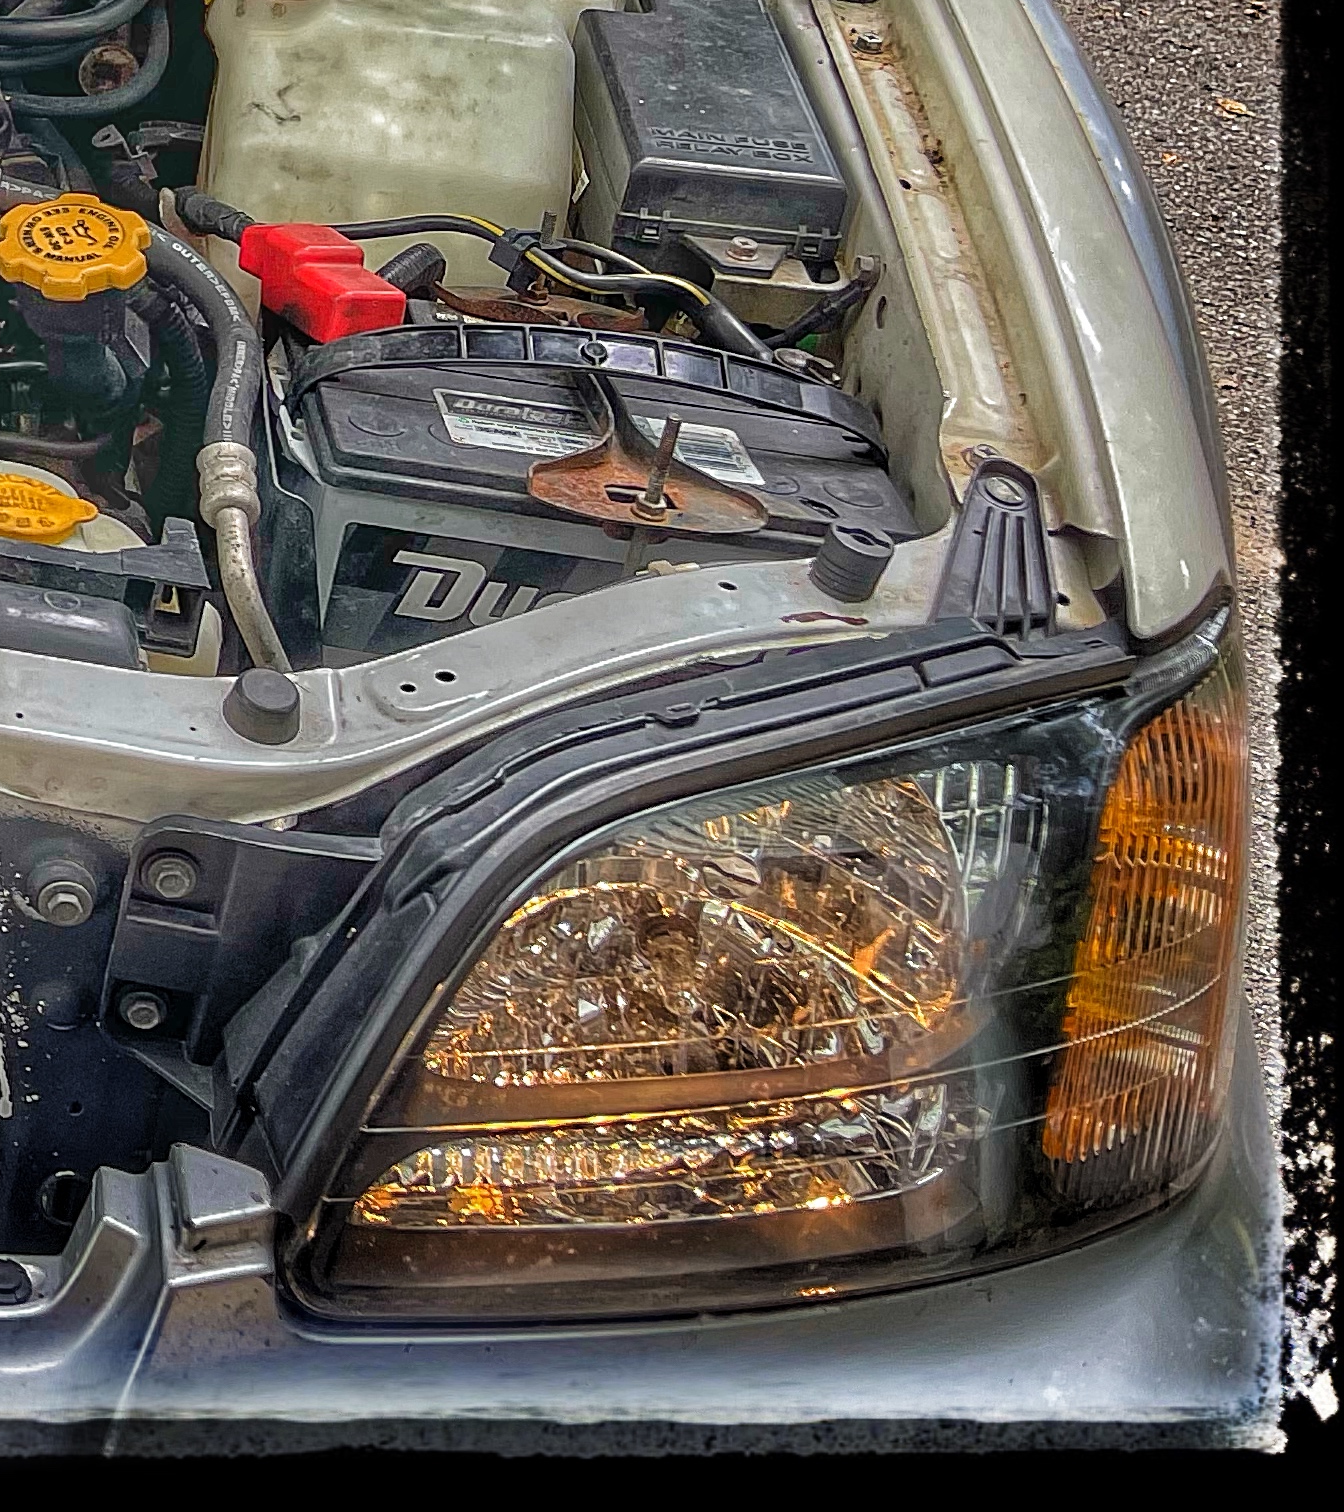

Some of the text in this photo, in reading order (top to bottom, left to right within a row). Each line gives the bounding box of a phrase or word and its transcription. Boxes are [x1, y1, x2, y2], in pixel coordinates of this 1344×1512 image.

[651, 128, 808, 150] MAIN FUSE
[656, 141, 813, 164] RELAY BOX
[78, 208, 120, 249] ENGINE OIL
[43, 252, 103, 263] MANUAL
